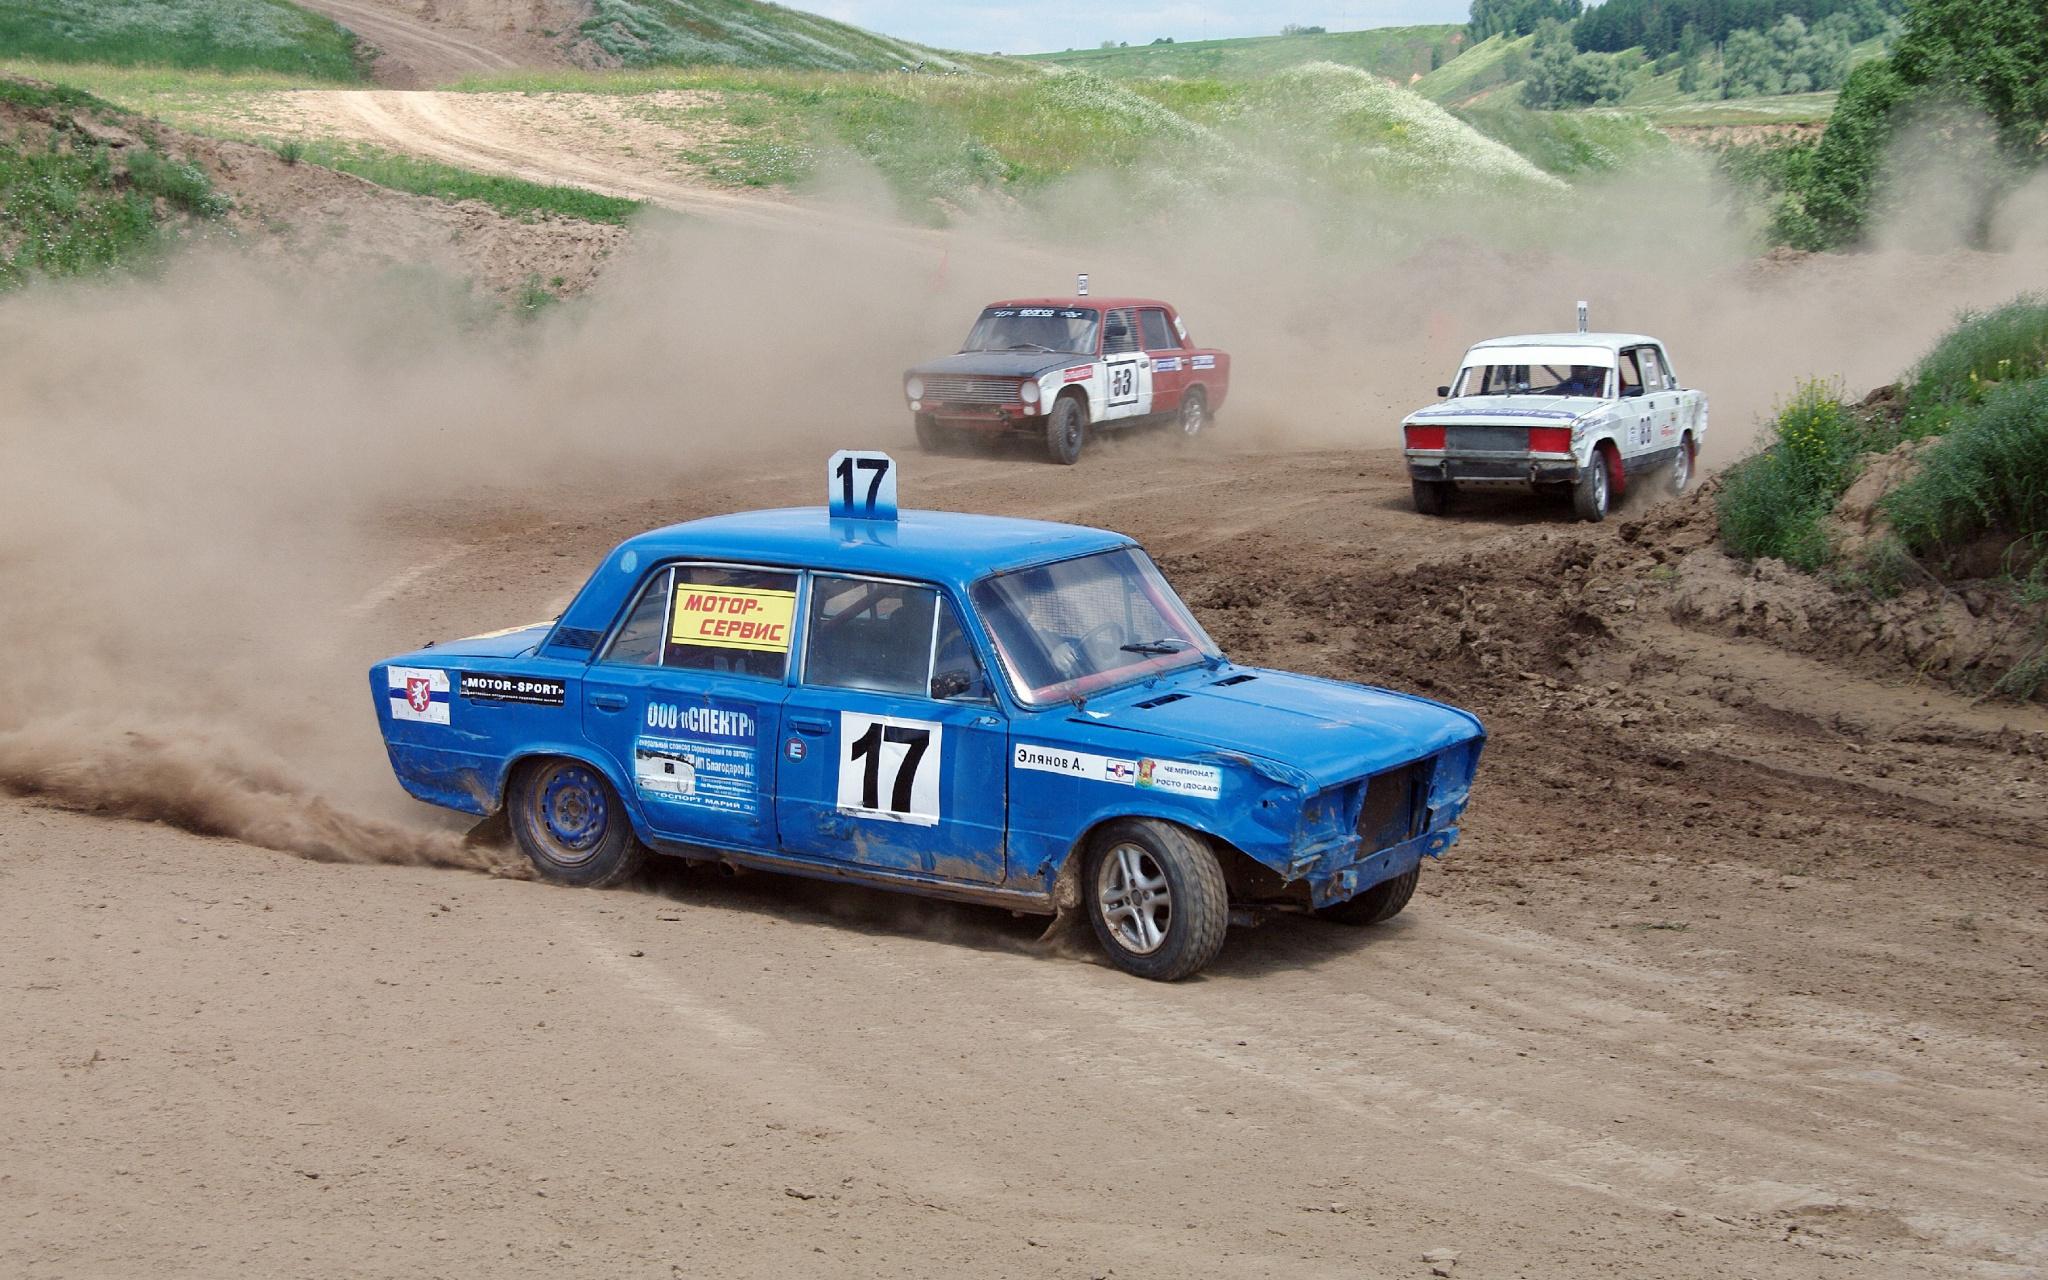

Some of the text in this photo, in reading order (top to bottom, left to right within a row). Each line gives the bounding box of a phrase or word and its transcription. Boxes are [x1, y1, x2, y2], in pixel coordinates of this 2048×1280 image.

[1113, 368, 1132, 398] 53
[836, 457, 890, 513] 17
[684, 594, 763, 615] МОТОР-
[699, 619, 784, 641] СЕРВИС
[789, 742, 802, 758] E
[1017, 749, 1085, 771] Элянов А.
[851, 722, 931, 814] 17
[1164, 765, 1214, 778] ЧЕМПИОНАТ
[1156, 778, 1181, 788] РОСТО
[705, 798, 741, 808] МАРИЙ
